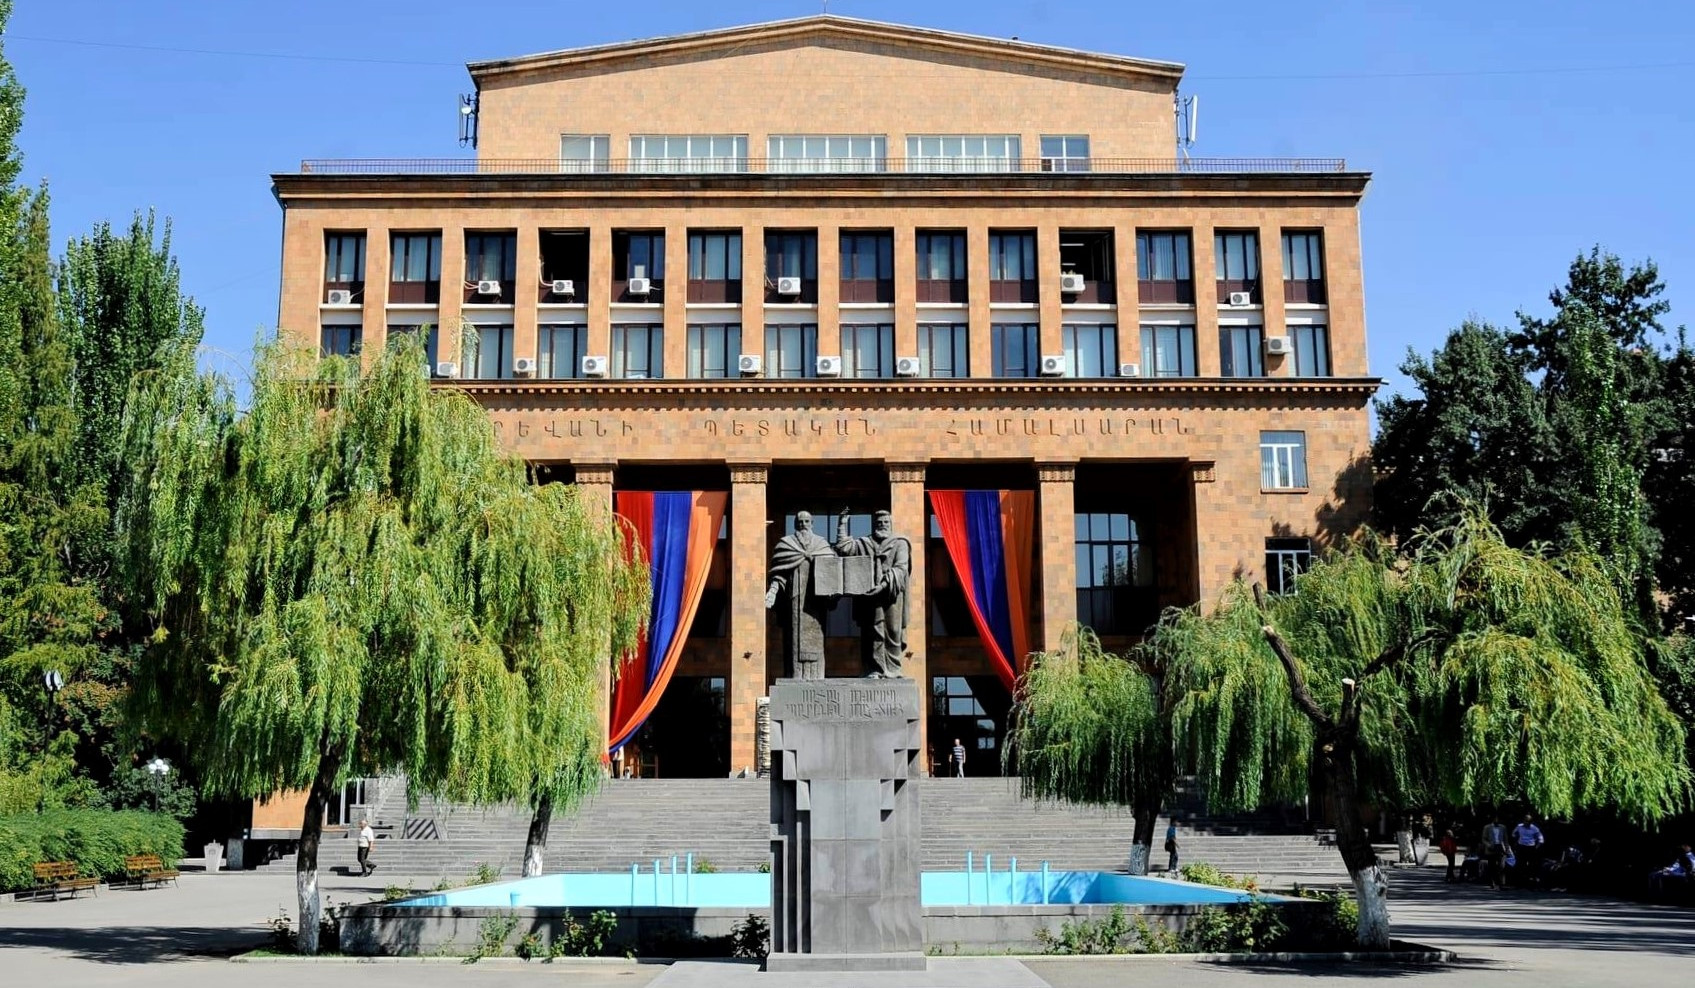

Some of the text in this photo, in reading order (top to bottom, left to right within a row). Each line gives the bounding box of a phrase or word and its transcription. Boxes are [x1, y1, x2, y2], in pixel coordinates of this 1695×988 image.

[493, 417, 1188, 438] ՐԵՎԱՆԻ ՊԵՏԱԿԱՆ ՀԱՄԱԼՍԱՐԱՆ
